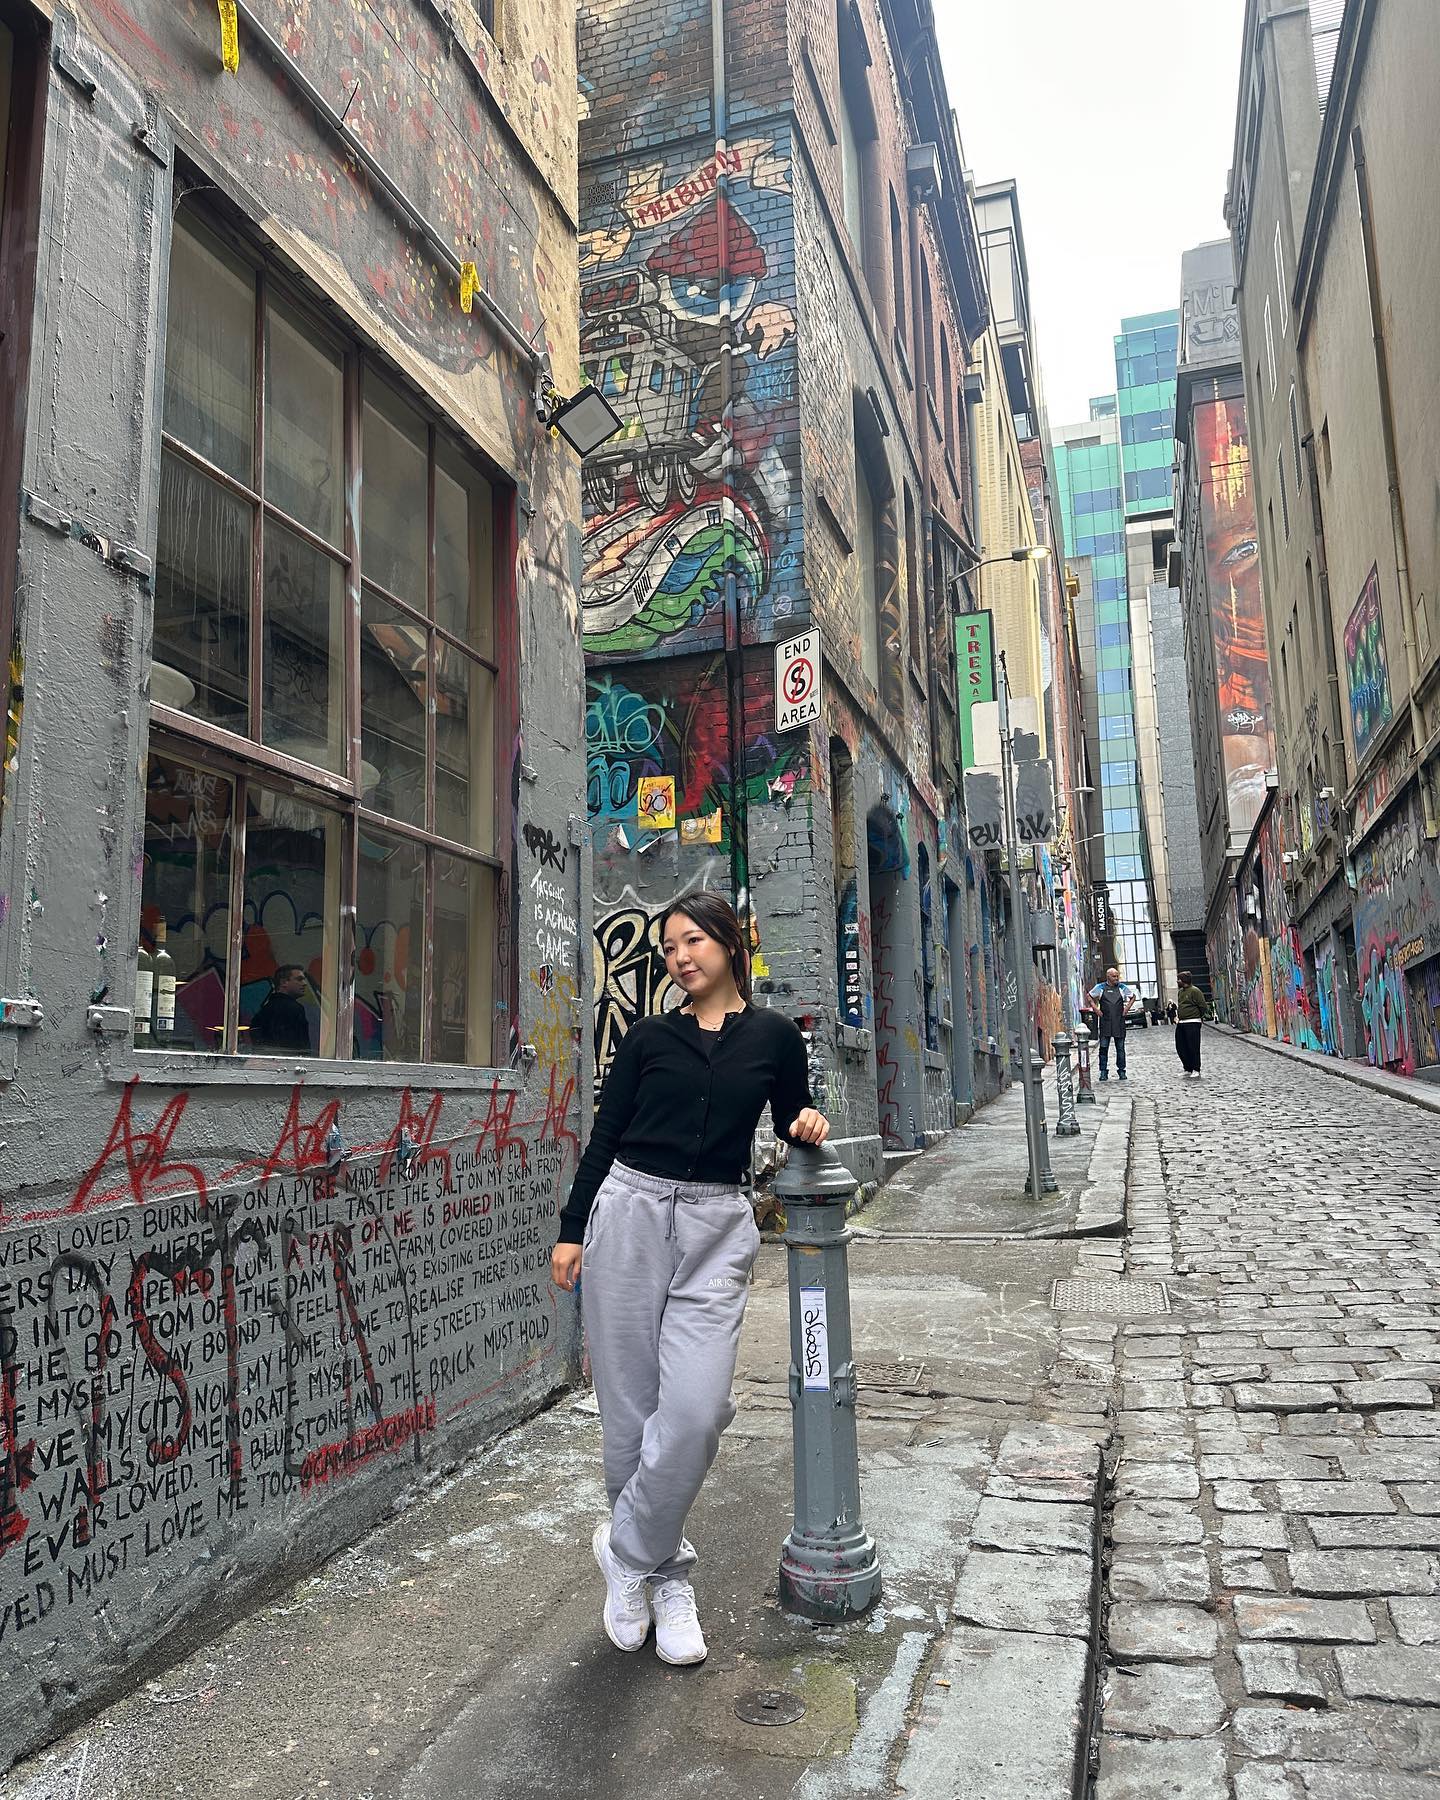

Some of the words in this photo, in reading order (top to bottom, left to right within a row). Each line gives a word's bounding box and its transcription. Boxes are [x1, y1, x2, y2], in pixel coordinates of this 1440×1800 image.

[785, 638, 811, 660] END
[966, 624, 982, 686] TRES
[780, 702, 817, 727] AREA
[534, 903, 544, 921] IS
[1097, 896, 1106, 931] MASONS
[57, 1217, 133, 1255] LOVED.
[143, 1202, 197, 1238] BURN
[244, 1186, 269, 1211] ON
[277, 1182, 286, 1208] A
[346, 1165, 381, 1193] MADE
[285, 1204, 334, 1233] STILL
[345, 1189, 395, 1220] TASTE
[402, 1183, 430, 1206] THE
[468, 1172, 482, 1190] ON
[487, 1167, 503, 1187] MY
[33, 1303, 95, 1348] INTO
[394, 1210, 412, 1237] ME
[423, 1204, 435, 1228] IS
[443, 1194, 491, 1224] BURIED
[494, 1189, 504, 1209] IN
[507, 1184, 526, 1203] THE
[530, 1178, 552, 1200] SAND
[239, 1277, 278, 1312] THE
[286, 1265, 327, 1299] DAM
[362, 1243, 392, 1272] THE
[440, 1217, 493, 1250] COVERED
[497, 1211, 507, 1233] IN
[512, 1207, 533, 1228] SILT
[535, 1200, 556, 1220] AND
[708, 1278, 723, 1287] AIR
[248, 1350, 272, 1396] MY
[385, 1301, 404, 1325] TO
[409, 1277, 464, 1318] REALISE
[472, 1261, 507, 1289] THERE
[510, 1259, 519, 1275] IS
[523, 1255, 534, 1271] NO
[268, 1312, 289, 1334] TO
[296, 1294, 333, 1325] FEEL
[379, 1336, 396, 1366] ON
[402, 1324, 429, 1354] THE
[433, 1301, 486, 1342] STREETS
[498, 1284, 543, 1312] WANDER.
[429, 1341, 475, 1395] BRICK
[484, 1321, 514, 1359] MUST
[520, 1315, 549, 1345] HOLD
[68, 1533, 134, 1605] MUST
[145, 1500, 206, 1557] LOVE
